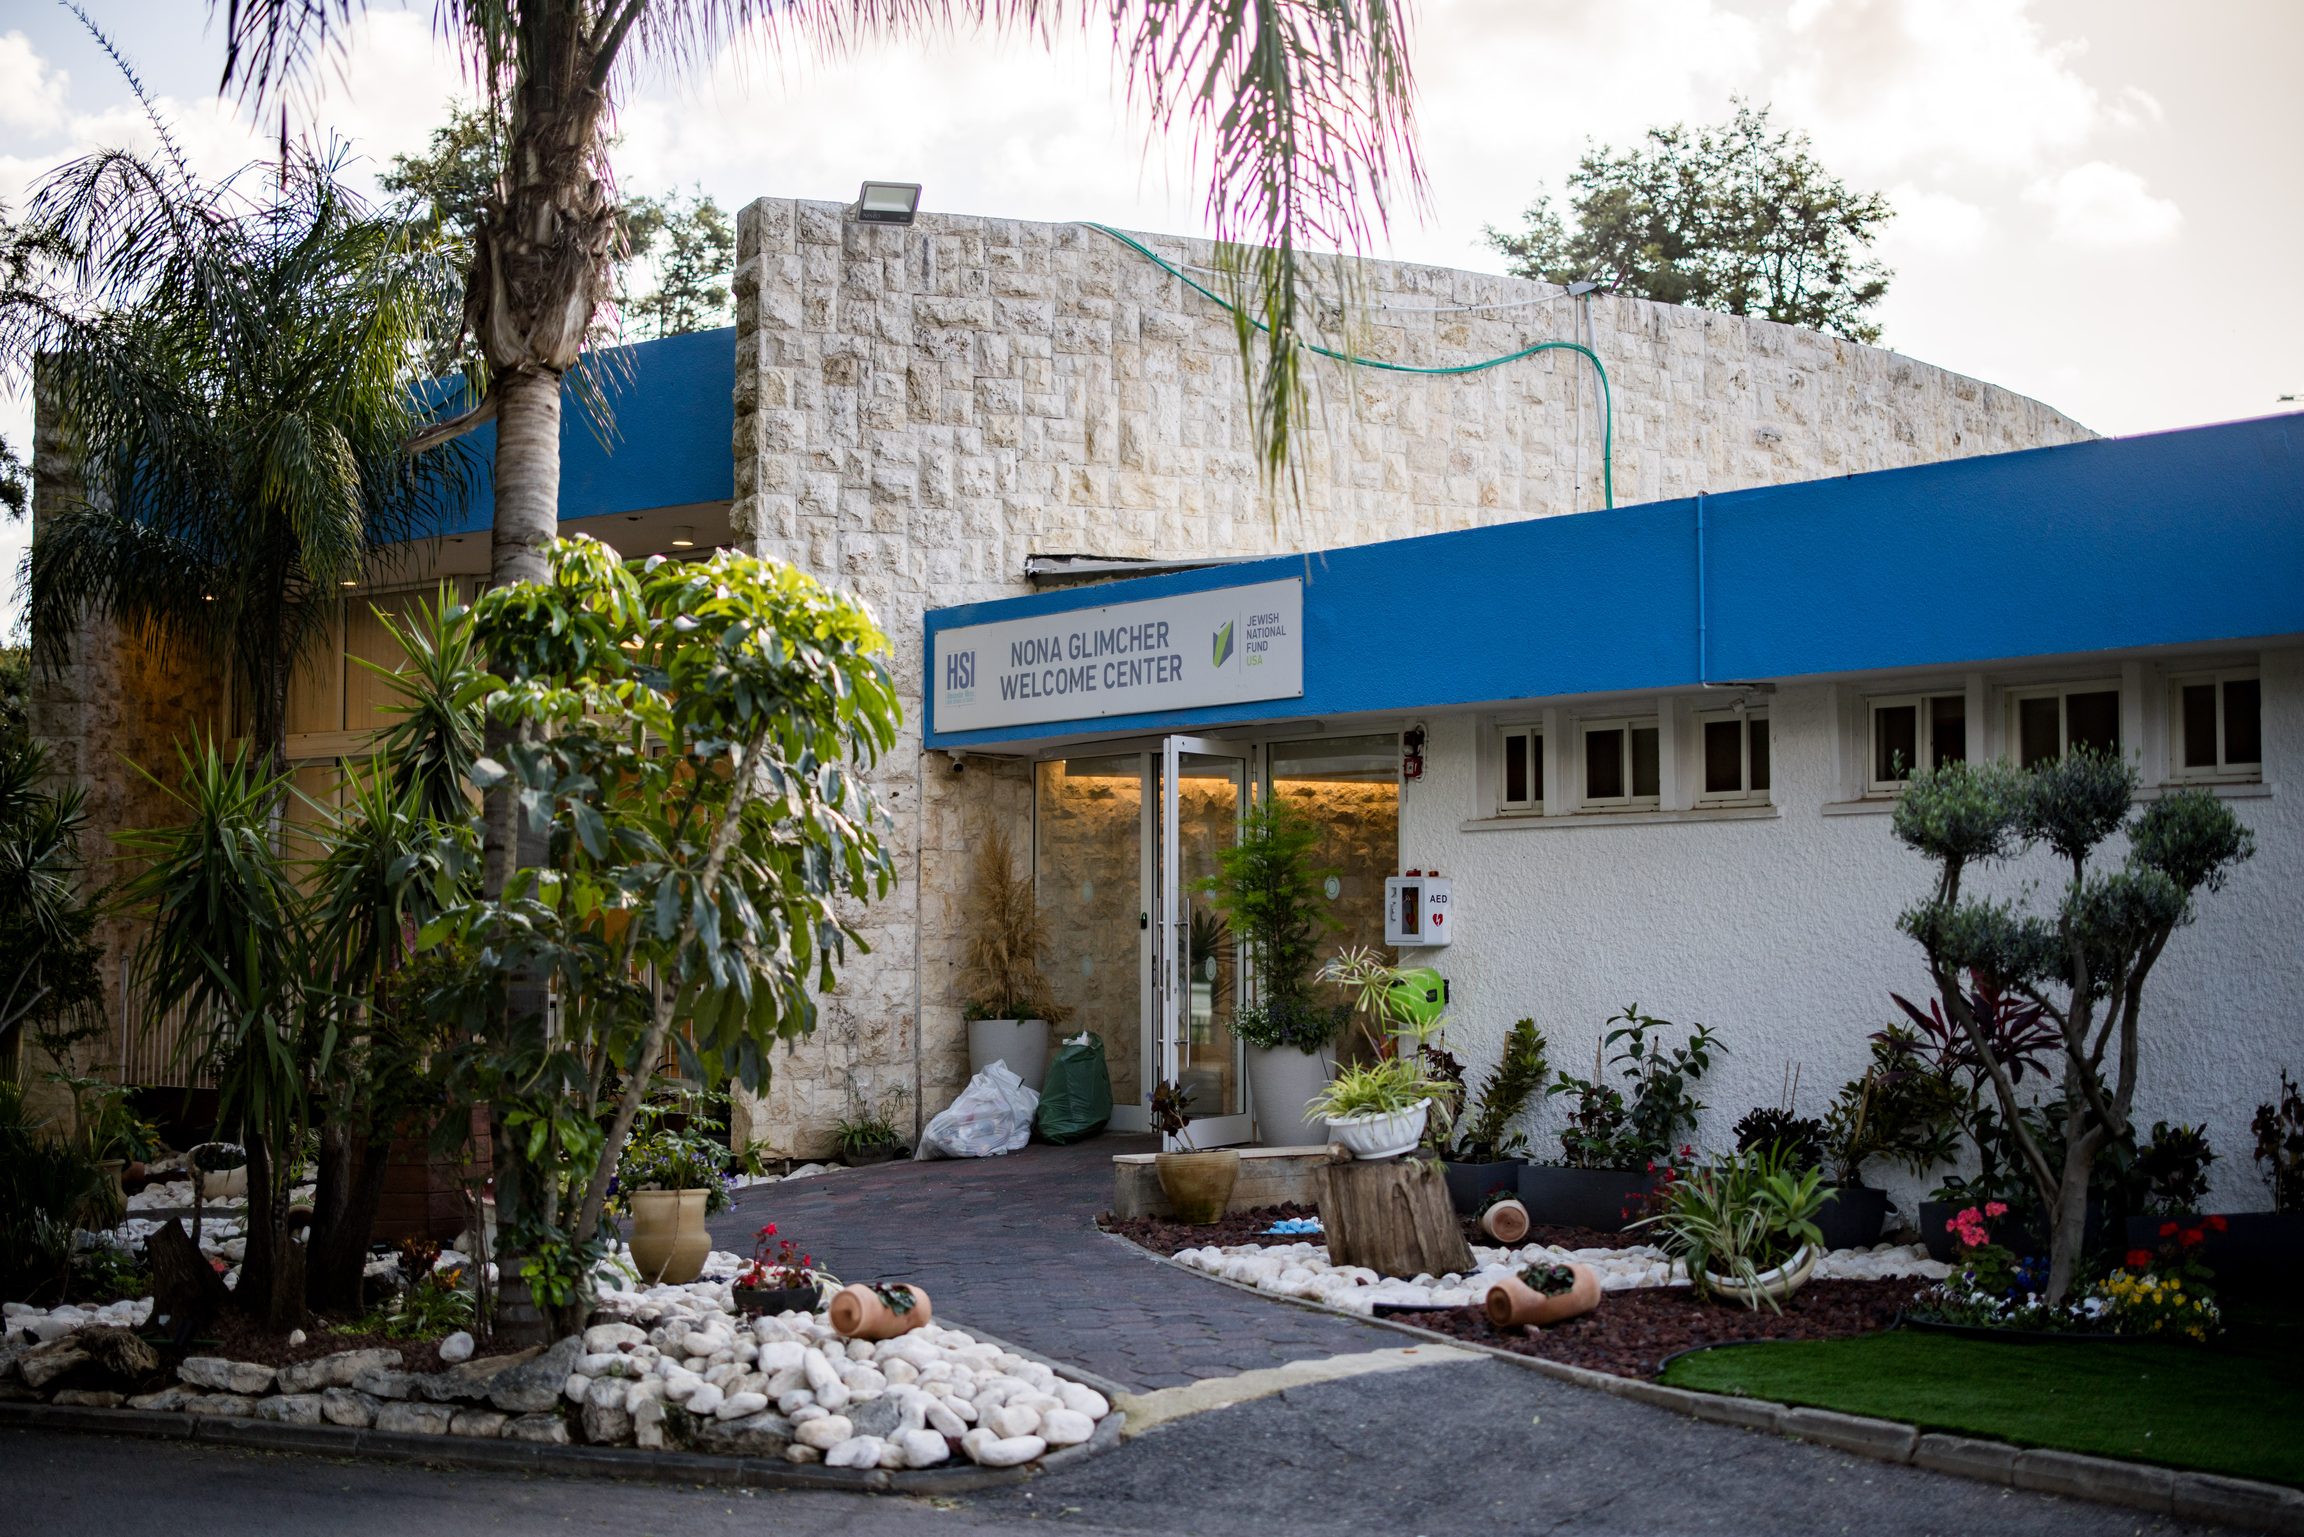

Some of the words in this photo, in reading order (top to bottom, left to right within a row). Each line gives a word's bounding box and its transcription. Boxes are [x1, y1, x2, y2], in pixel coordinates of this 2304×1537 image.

[1246, 612, 1279, 627] JEWISH
[1246, 625, 1287, 640] NATIONAL
[1011, 636, 1062, 667] NONA
[1068, 621, 1169, 660] GLIMCHER
[1246, 640, 1268, 653] FUND
[1246, 655, 1263, 666] USA
[947, 651, 975, 690] HSI
[1000, 664, 1097, 700] WELCOME
[1103, 654, 1182, 689] CENTER
[1429, 894, 1448, 903] AED
